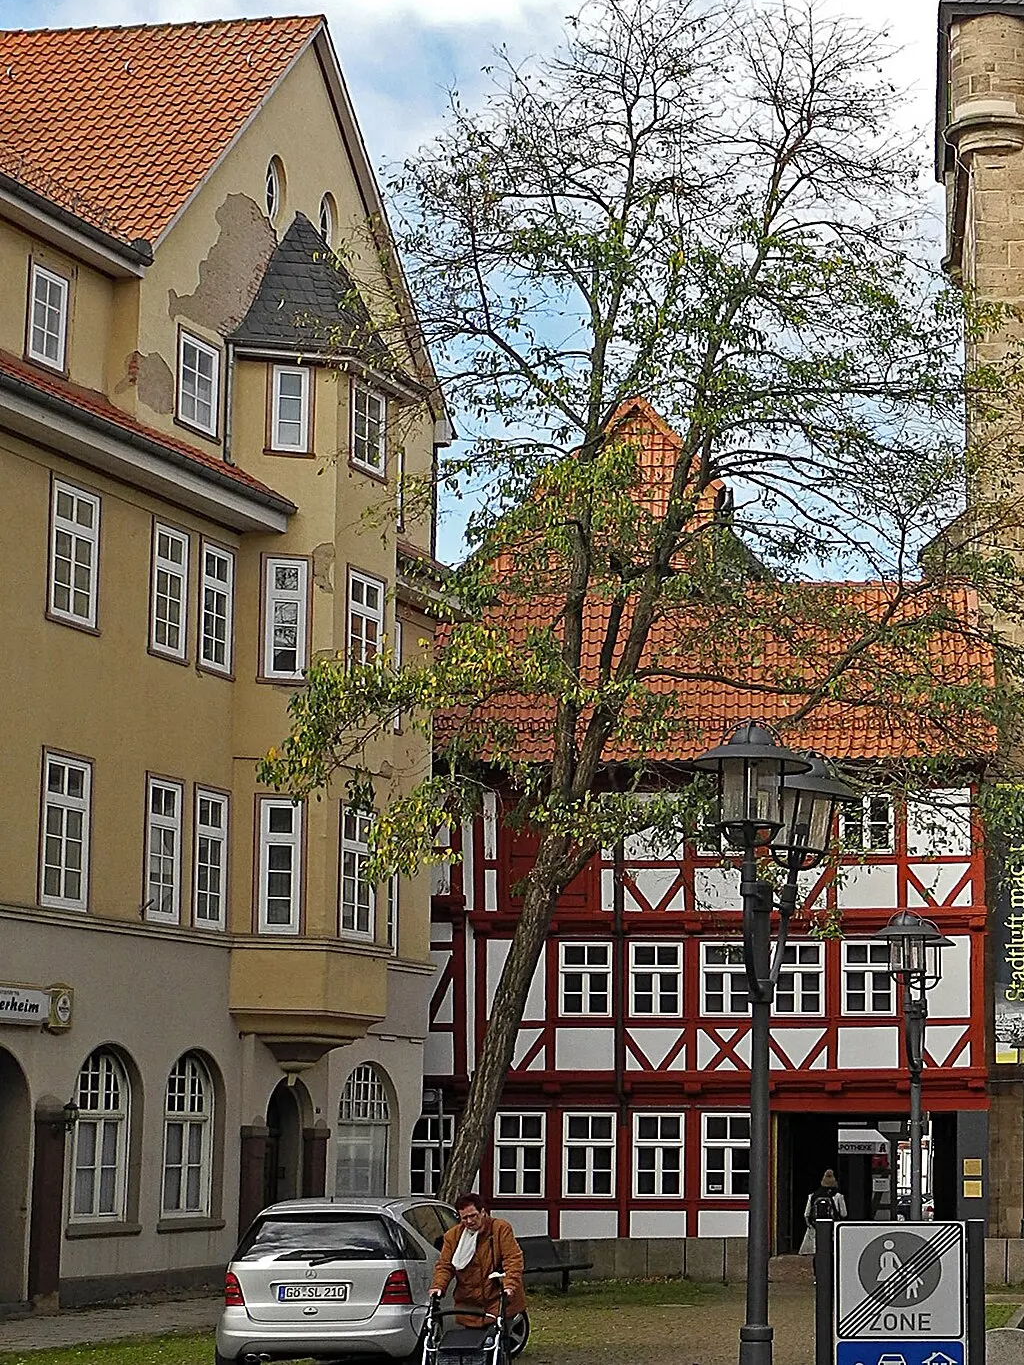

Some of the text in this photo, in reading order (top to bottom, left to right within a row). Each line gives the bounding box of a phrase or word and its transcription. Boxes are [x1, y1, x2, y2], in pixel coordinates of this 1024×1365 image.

[286, 1287, 344, 1297] GÖ SL 210
[869, 1313, 932, 1331] ZONE
